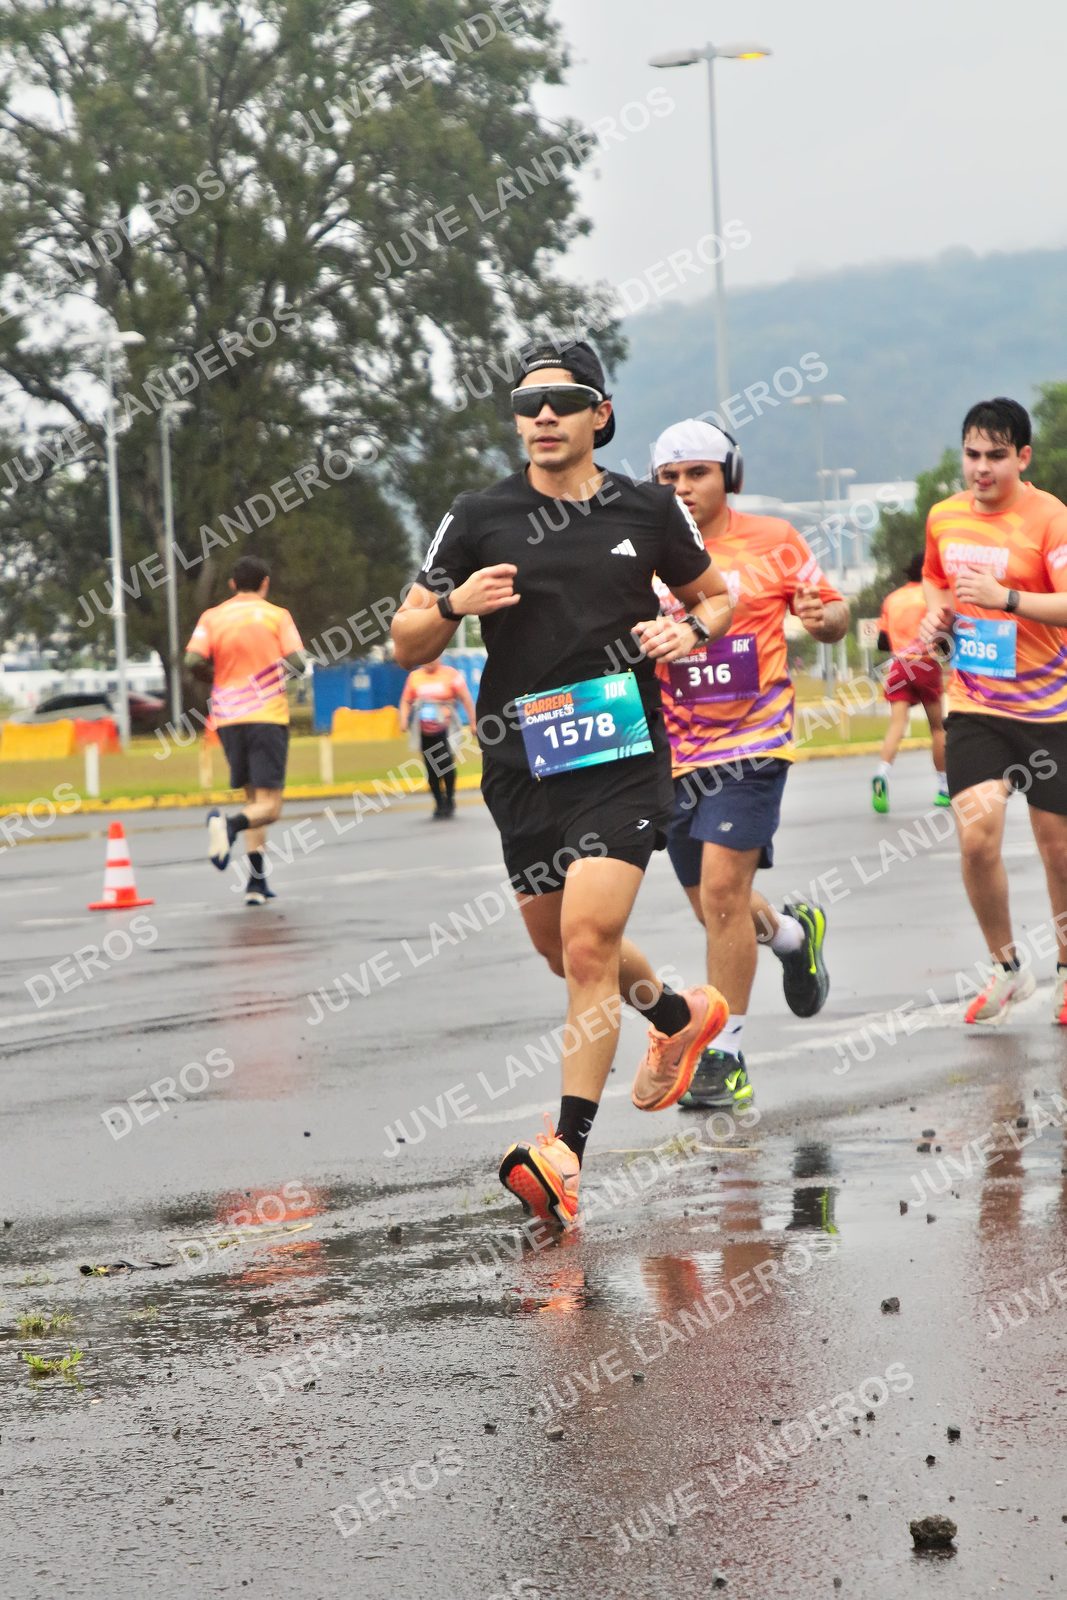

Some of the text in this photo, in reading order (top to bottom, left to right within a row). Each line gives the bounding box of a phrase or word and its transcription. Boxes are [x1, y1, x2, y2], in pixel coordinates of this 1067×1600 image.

[731, 639, 750, 654] 16K
[959, 637, 998, 660] 2036
[688, 663, 731, 687] 316
[604, 680, 627, 700] 10K
[524, 692, 573, 716] CARRERA
[543, 713, 616, 749] 1578
